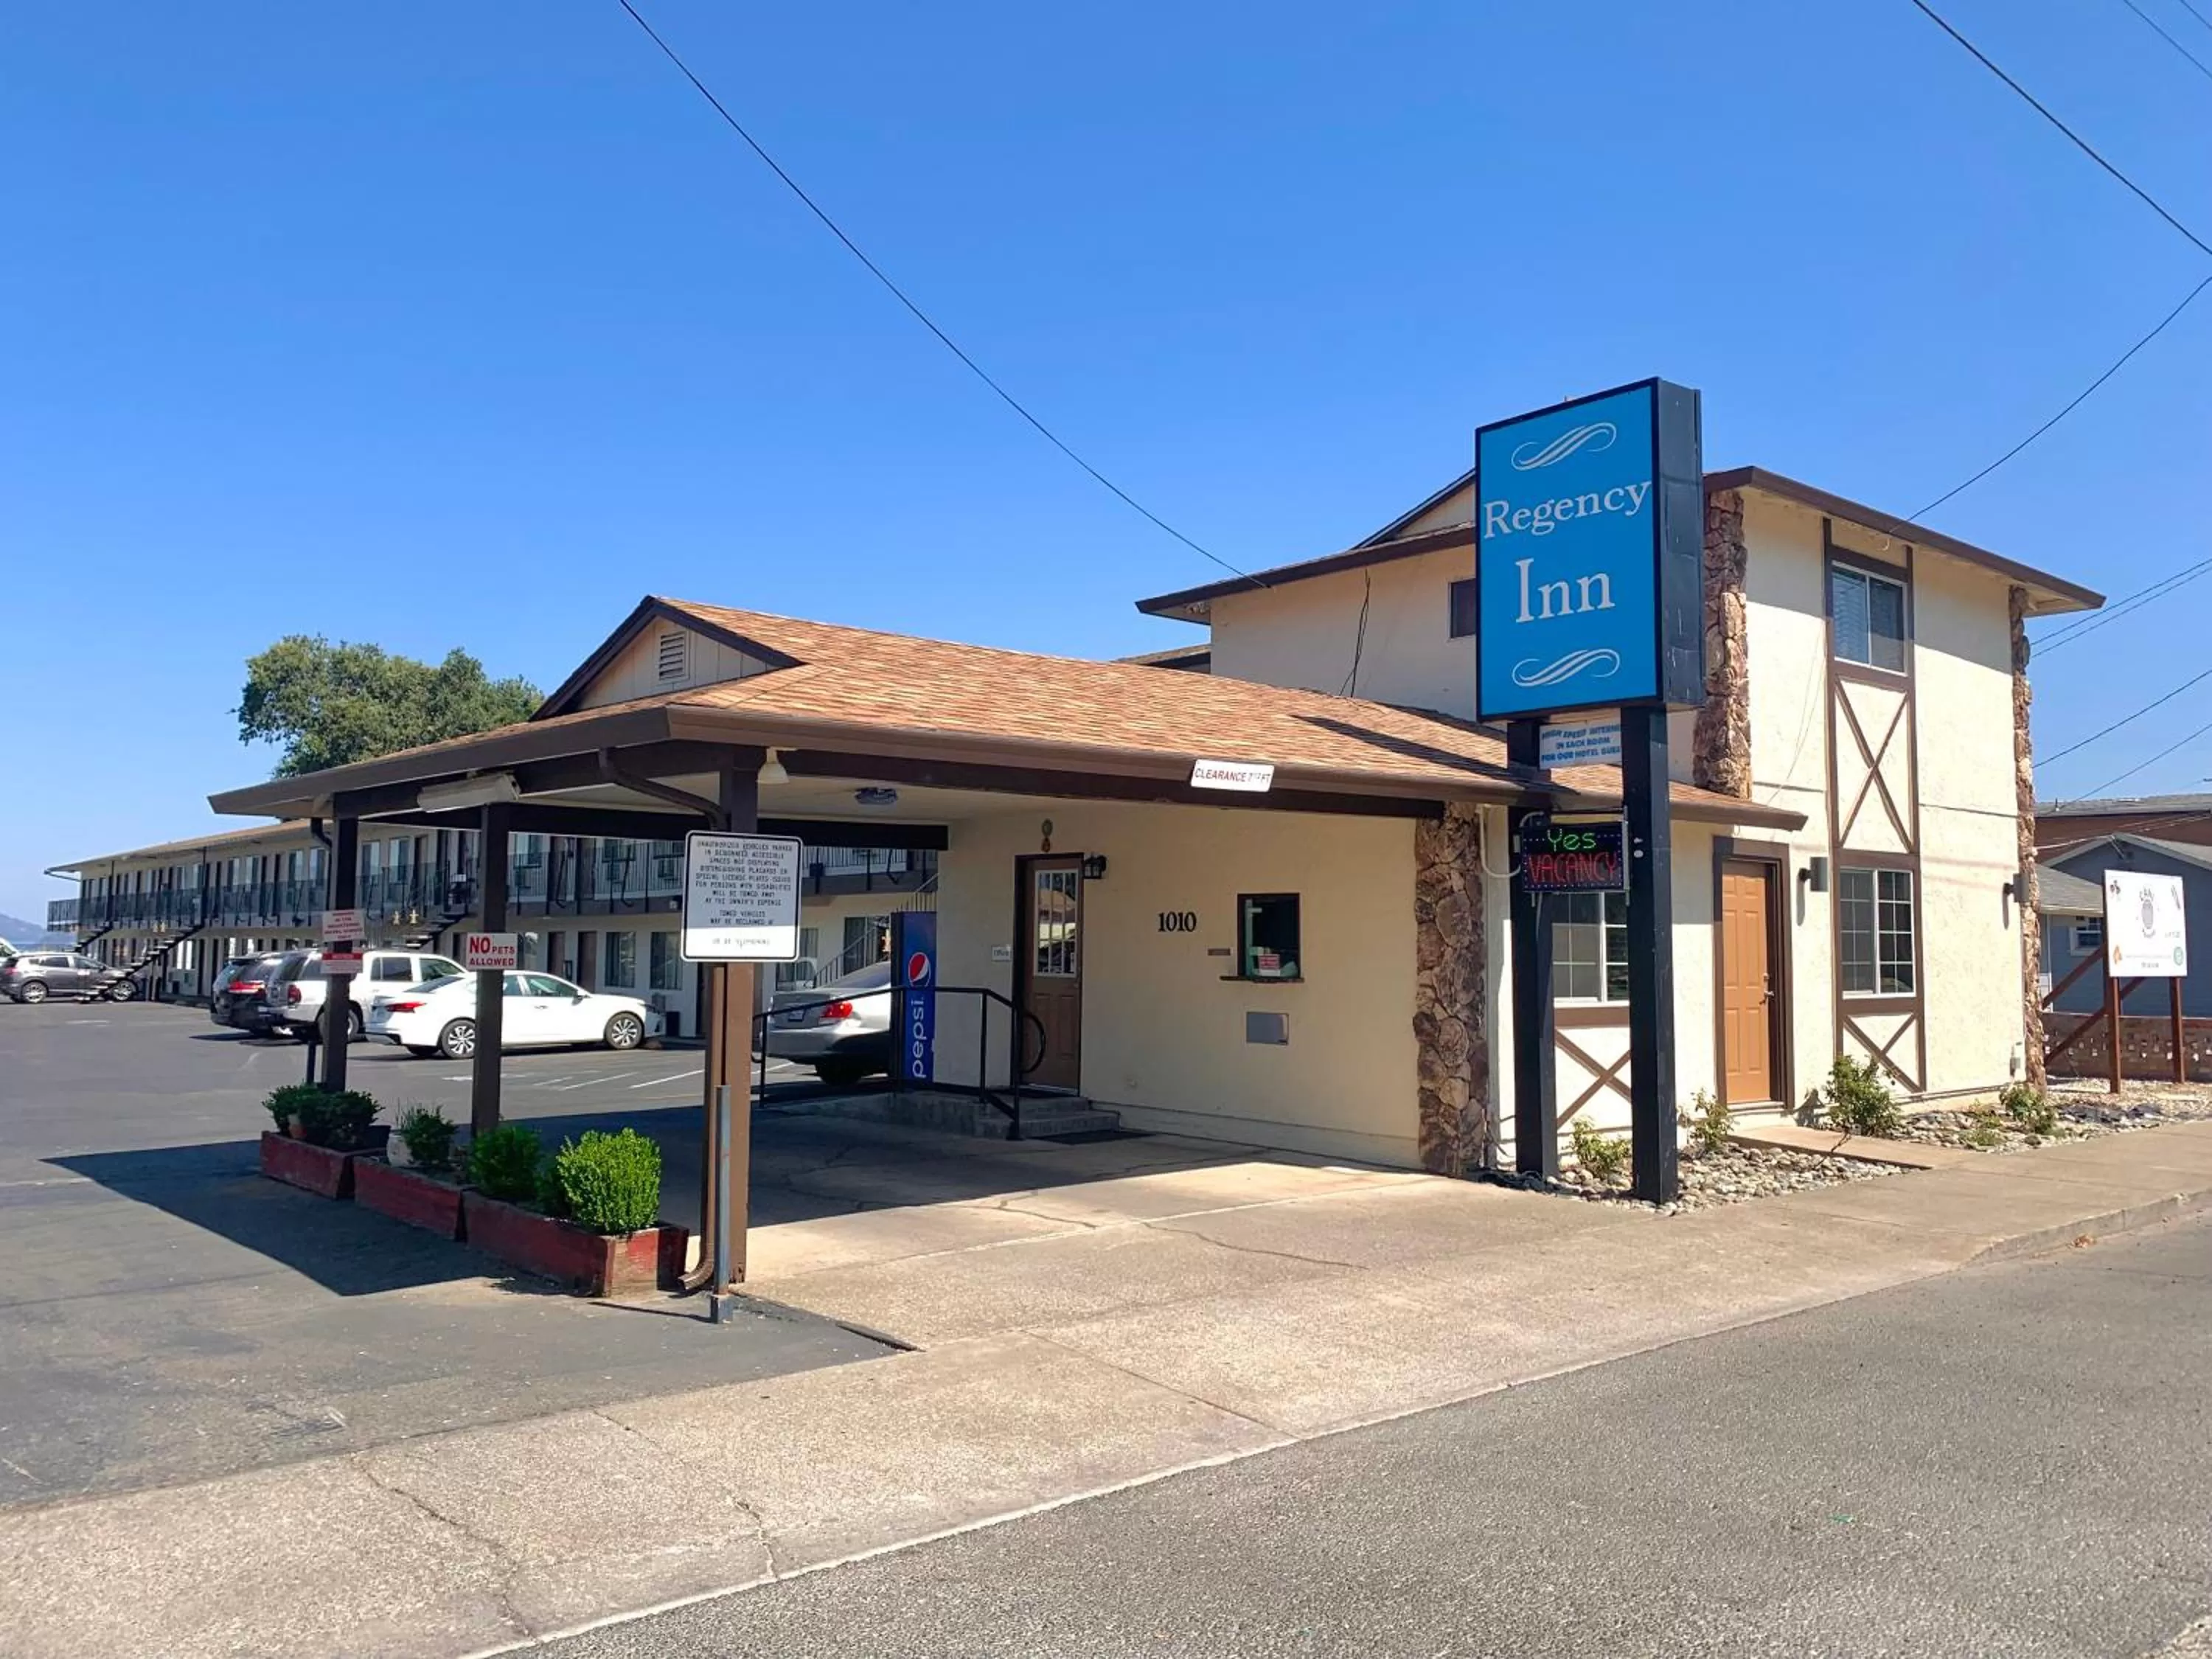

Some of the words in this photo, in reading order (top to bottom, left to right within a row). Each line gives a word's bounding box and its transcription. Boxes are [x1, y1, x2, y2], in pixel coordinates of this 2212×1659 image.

[1484, 480, 1651, 539] Regency
[1515, 558, 1615, 622] Inn
[1563, 728, 1586, 738] SPEED
[1588, 725, 1621, 735] INTERNE
[1557, 742, 1565, 750] IN
[1566, 740, 1585, 748] EACH
[1587, 737, 1610, 745] ROOM
[1542, 754, 1556, 762] FOR
[1575, 748, 1599, 757] HOTEL
[1194, 768, 1247, 782] CLEARANCE
[1547, 828, 1597, 852] Yes
[695, 872, 718, 880] SPECIAL
[1528, 852, 1618, 885] VACANCY
[1158, 911, 1197, 932] 1010
[470, 936, 490, 953] NO
[492, 945, 515, 954] PETS
[470, 958, 515, 966] ALLOWED
[911, 998, 927, 1079] pepsi
